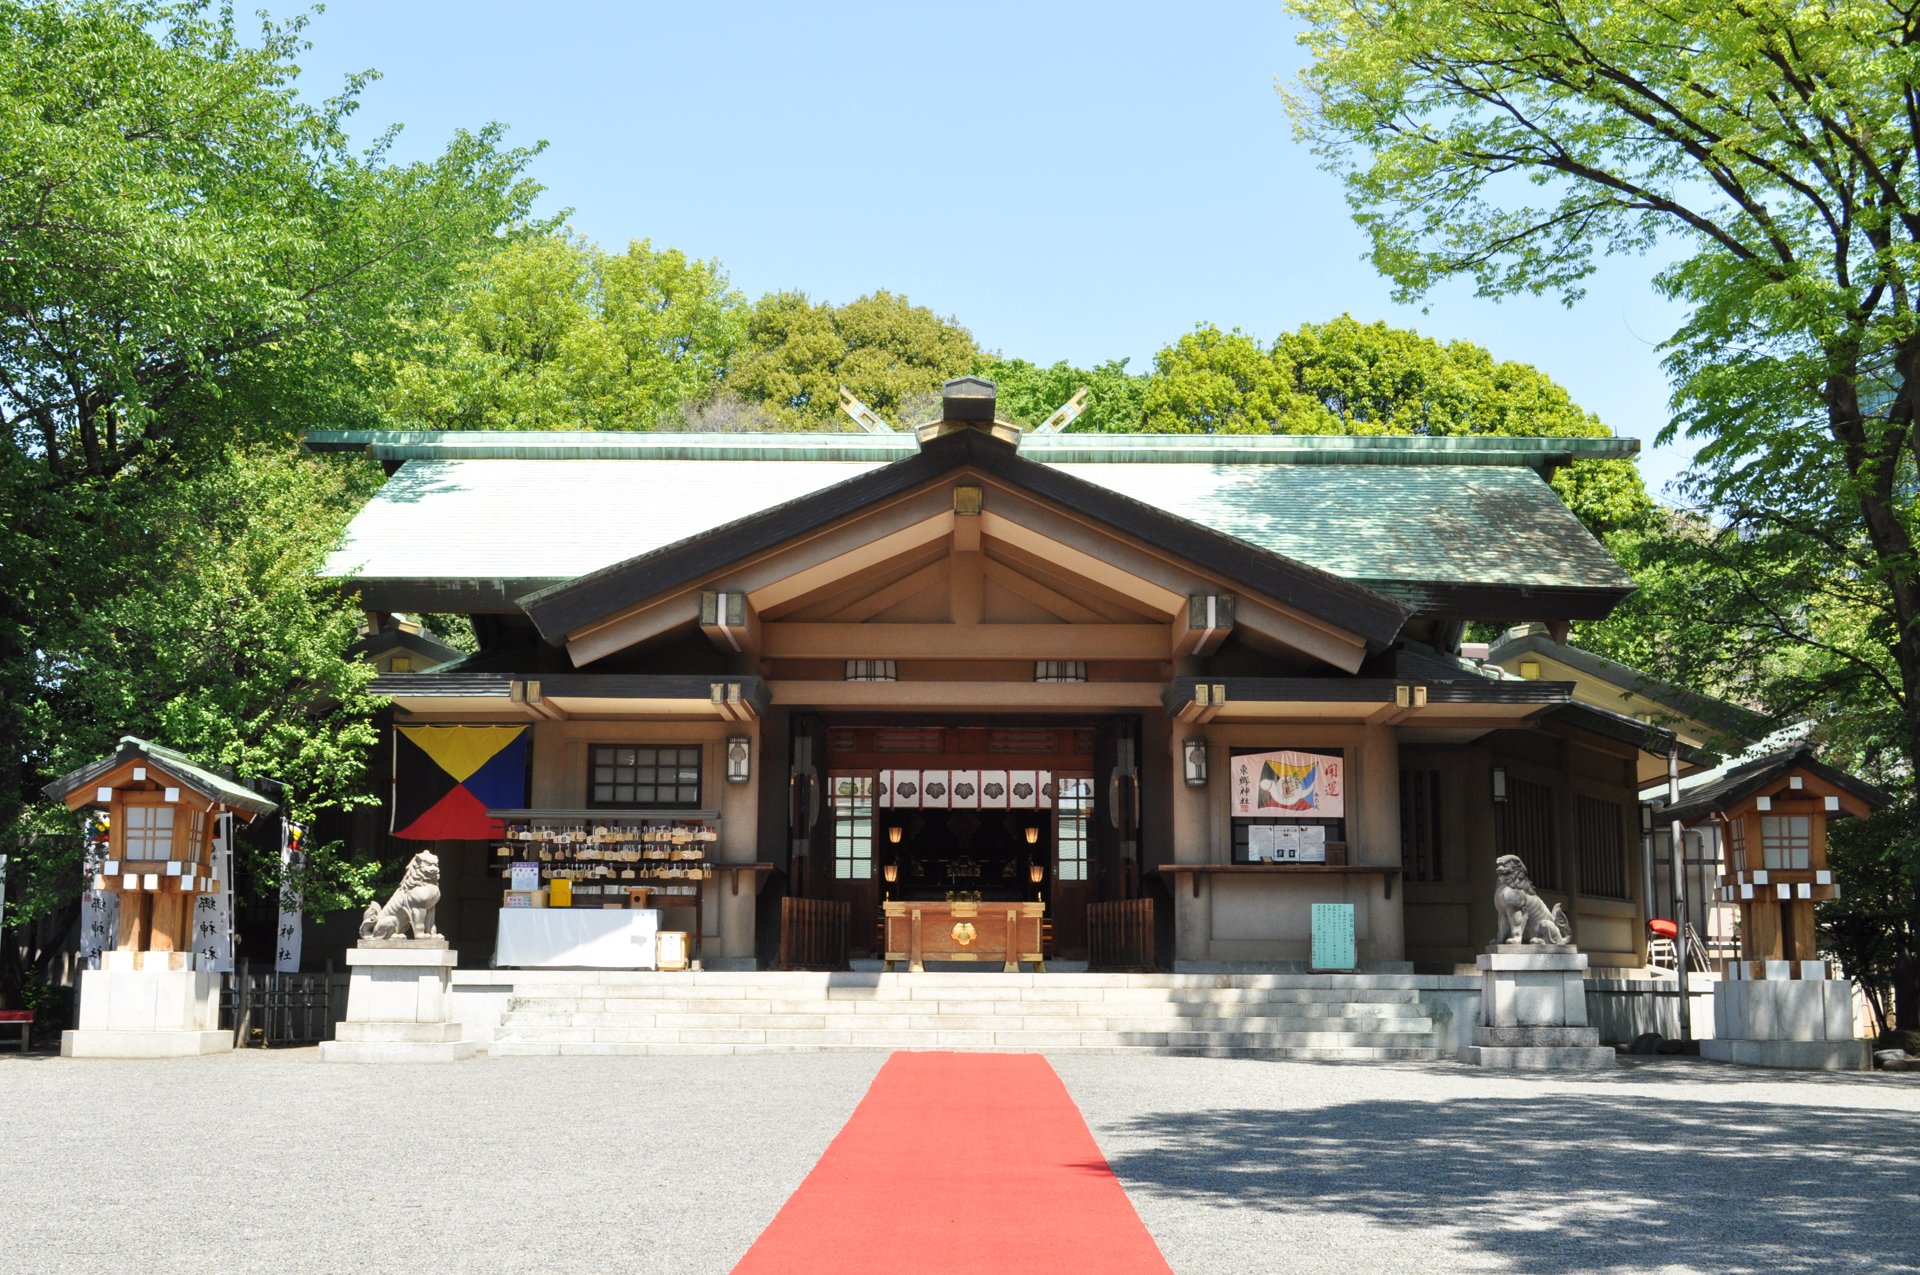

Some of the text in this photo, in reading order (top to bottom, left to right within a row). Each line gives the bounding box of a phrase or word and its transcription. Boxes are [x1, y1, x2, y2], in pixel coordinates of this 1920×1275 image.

[1239, 764, 1250, 805] 東郷神社
[1325, 763, 1340, 797] 開運
